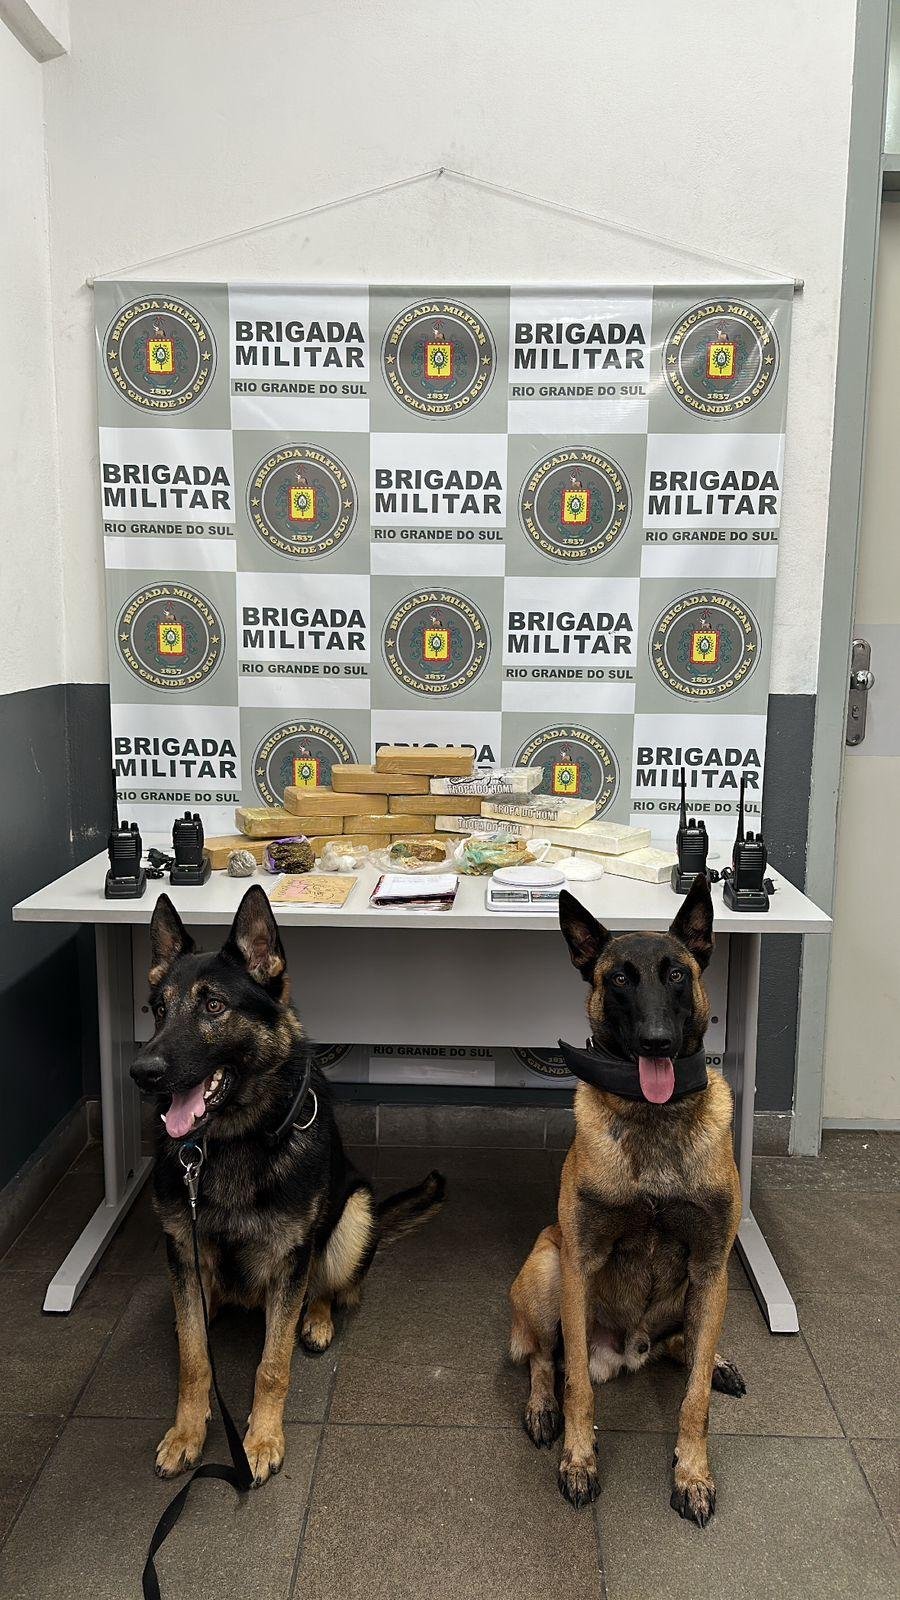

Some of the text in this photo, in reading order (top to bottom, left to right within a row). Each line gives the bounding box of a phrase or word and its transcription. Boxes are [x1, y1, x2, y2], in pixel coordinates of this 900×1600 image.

[112, 302, 206, 342] BRIGADA MILITAR
[236, 321, 365, 343] BRIGADA
[390, 305, 486, 345] BRIGADA MILITAR
[672, 305, 770, 346] BRIGADA MILITAR
[515, 323, 646, 344] BRIGADA
[236, 346, 364, 368] MILITAR
[514, 348, 644, 369] MILITAR
[112, 367, 208, 408] RIO GRANDE DO SUL
[150, 389, 172, 397] 1837
[234, 382, 367, 394] RIO GRANDE DO SUL
[389, 371, 487, 413] RIO GRANDE DO SUL
[513, 386, 646, 396] RIO GRANDE DO SUL
[671, 372, 769, 413] RIO GRANDE DO SUL
[103, 464, 230, 486] BRIGADA
[255, 449, 347, 489] BRIGADA MILITAR
[376, 469, 502, 490] BRIGADA
[529, 453, 622, 492] BRIGADA MILITAR
[650, 471, 779, 491] BRIGADA
[104, 487, 230, 510] MILITAR
[376, 493, 501, 514] MILITAR
[648, 494, 777, 515] MILITAR
[104, 523, 234, 536] RIO GRANDE DO SUL
[255, 514, 348, 554] RIO GRANDE DO SUL
[293, 535, 313, 543] 1837
[374, 530, 503, 540] RIO GRANDE DO SUL
[527, 518, 621, 557] RIO GRANDE DO SUL
[646, 532, 778, 541] RIO GRANDE DO SUL
[123, 587, 214, 626] BRIGADA MILITAR
[390, 593, 481, 631] BRIGADA MILITAR
[659, 596, 751, 633] BRIGADA MILITAR
[243, 607, 366, 628] BRIGADA
[508, 612, 633, 631] BRIGADA
[243, 630, 366, 650] MILITAR
[508, 634, 631, 654] MILITAR
[124, 648, 217, 686] RIO GRANDE DO SUL
[242, 664, 368, 675] RIO GRANDE DO SUL
[389, 655, 482, 692] RIO GRANDE DO SUL
[506, 669, 633, 679] RIO GRANDE DO SUL
[656, 658, 751, 695] RIO GRANDE DO SUL
[114, 737, 237, 757] BRIGADA
[260, 726, 307, 759] BRIGADA
[309, 726, 349, 761] MILITAR
[520, 731, 568, 764] BRIGADA
[572, 730, 610, 766] MILITAR
[637, 747, 761, 767] BRIGADA
[115, 759, 237, 778] MILITAR
[636, 768, 759, 789] MILITAR
[116, 791, 240, 802] RIO GRANDE DO SUL
[259, 782, 274, 803] RIO
[633, 801, 655, 810] RIO
[715, 803, 732, 812] DO
[373, 1046, 494, 1058] RIO GRANDE DO SUL
[527, 1057, 572, 1075] GRANDE
